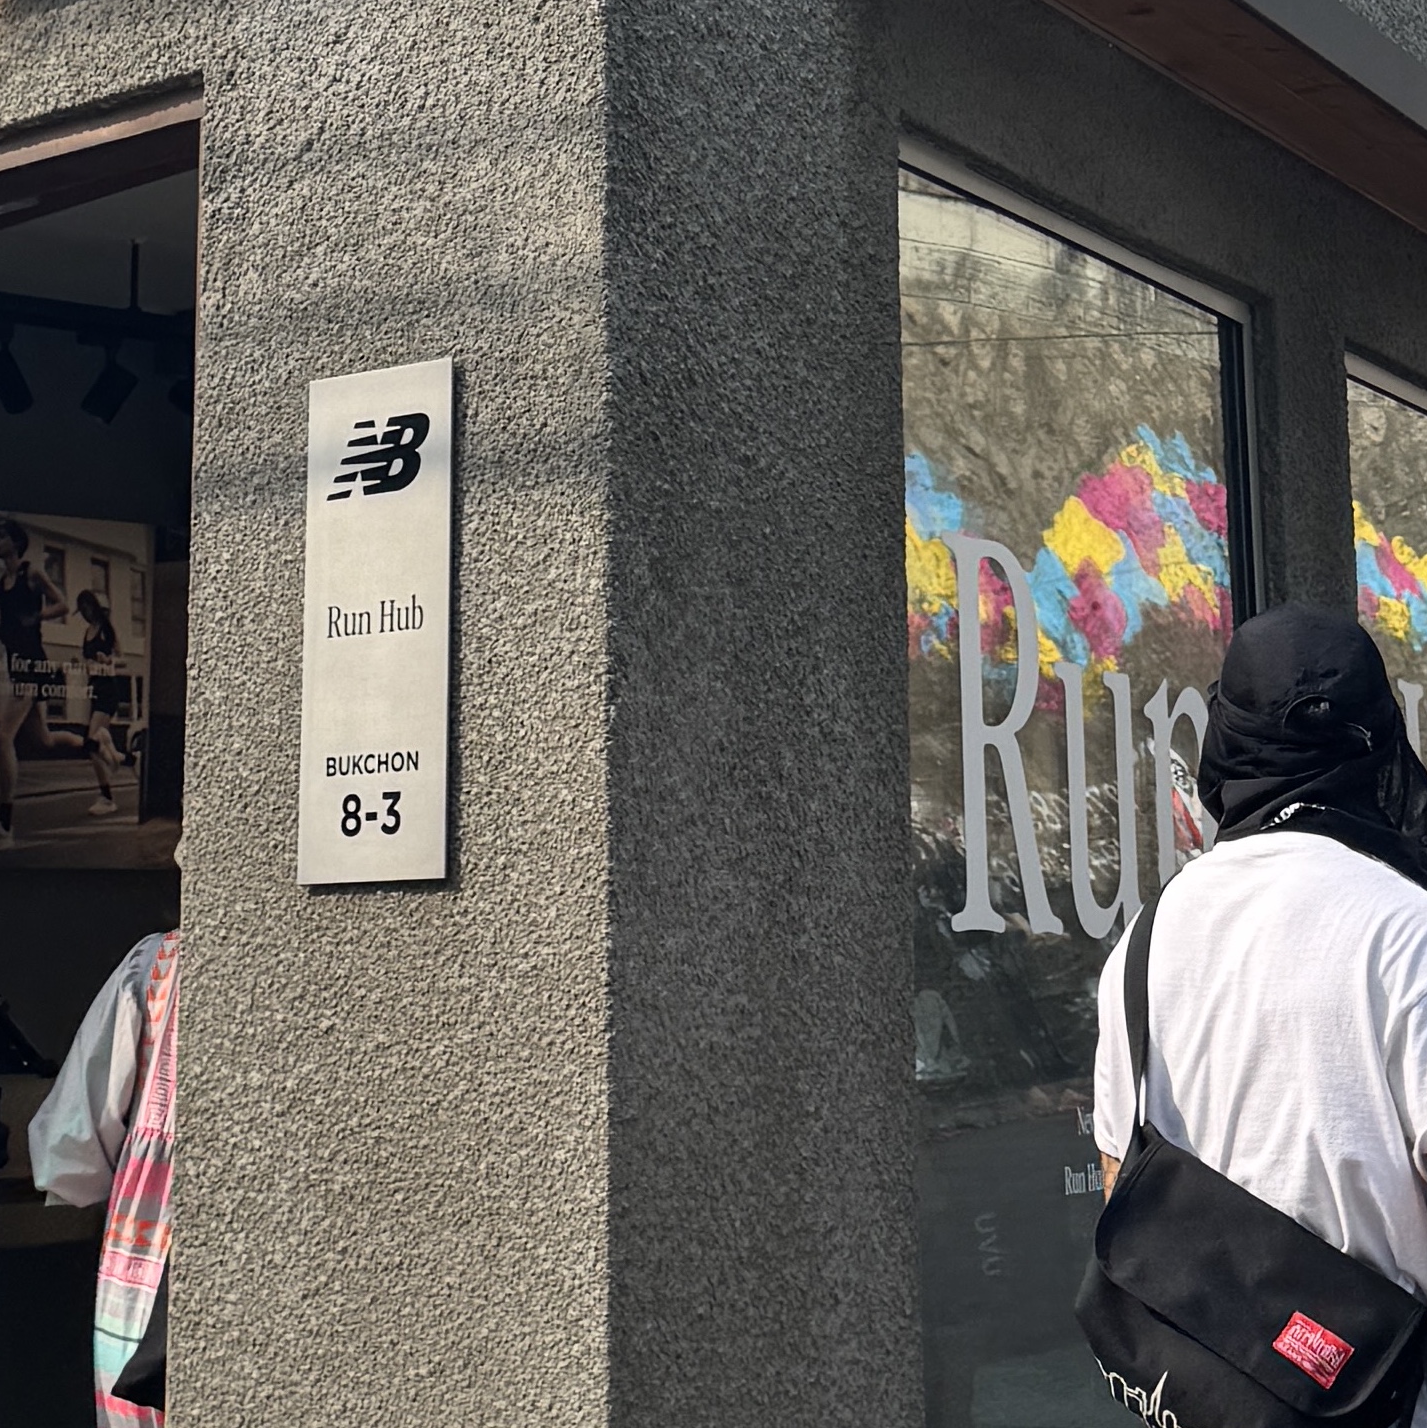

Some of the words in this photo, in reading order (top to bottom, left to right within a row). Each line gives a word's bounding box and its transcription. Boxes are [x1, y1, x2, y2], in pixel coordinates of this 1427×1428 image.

[326, 604, 372, 640] Run
[378, 594, 424, 635] Hub
[10, 652, 32, 672] for
[34, 659, 61, 678] any
[325, 750, 420, 778] BUKCHON
[340, 790, 402, 838] 8-3
[1064, 1165, 1087, 1196] Run
[1086, 1162, 1104, 1192] Hu
